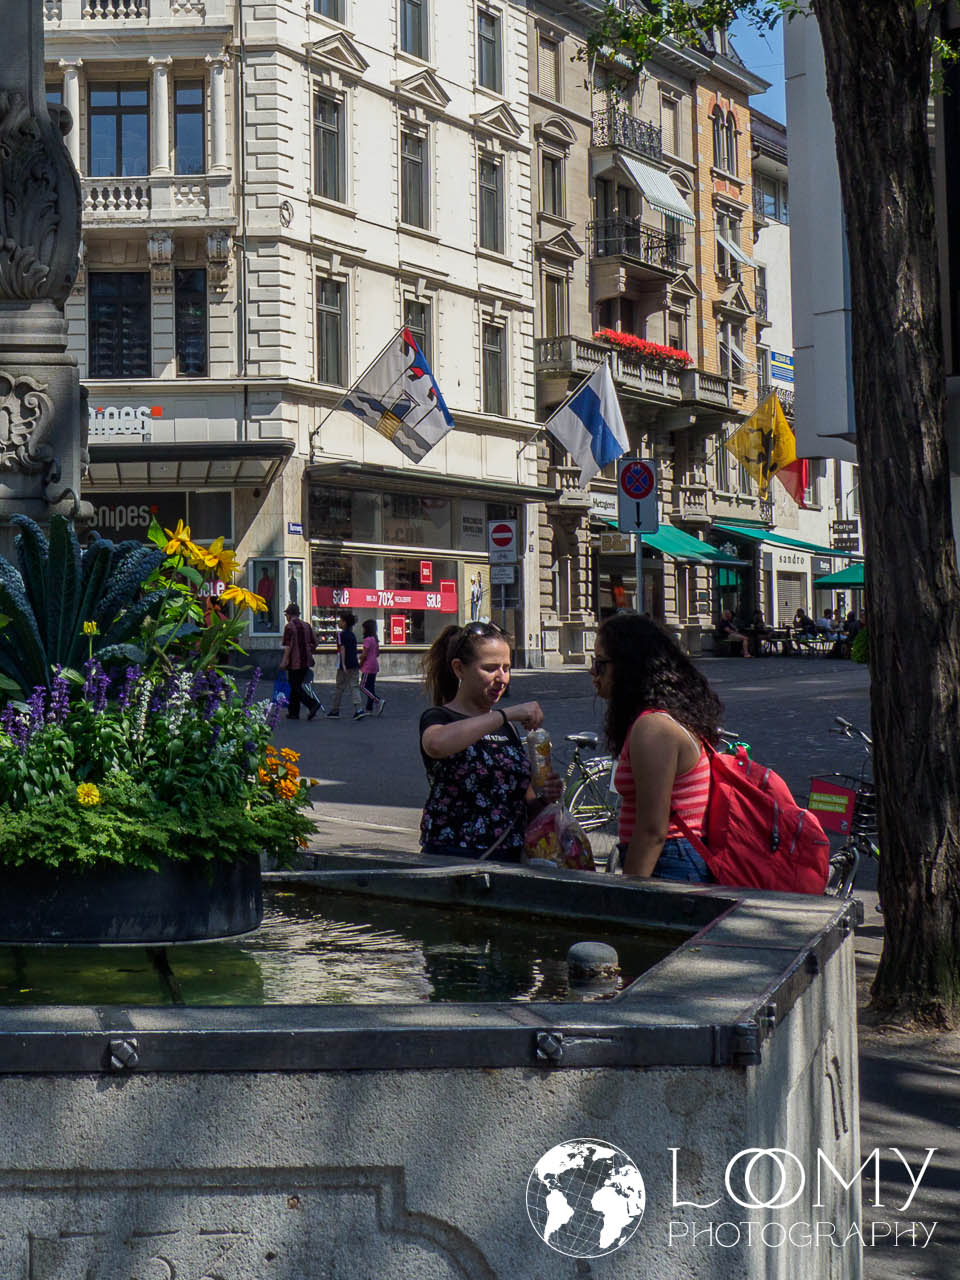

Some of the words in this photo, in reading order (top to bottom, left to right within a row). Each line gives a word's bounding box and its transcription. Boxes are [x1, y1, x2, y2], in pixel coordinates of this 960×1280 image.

[780, 554, 804, 565] sandro
[333, 590, 349, 605] sale
[378, 592, 394, 606] 70%
[426, 593, 441, 608] sale
